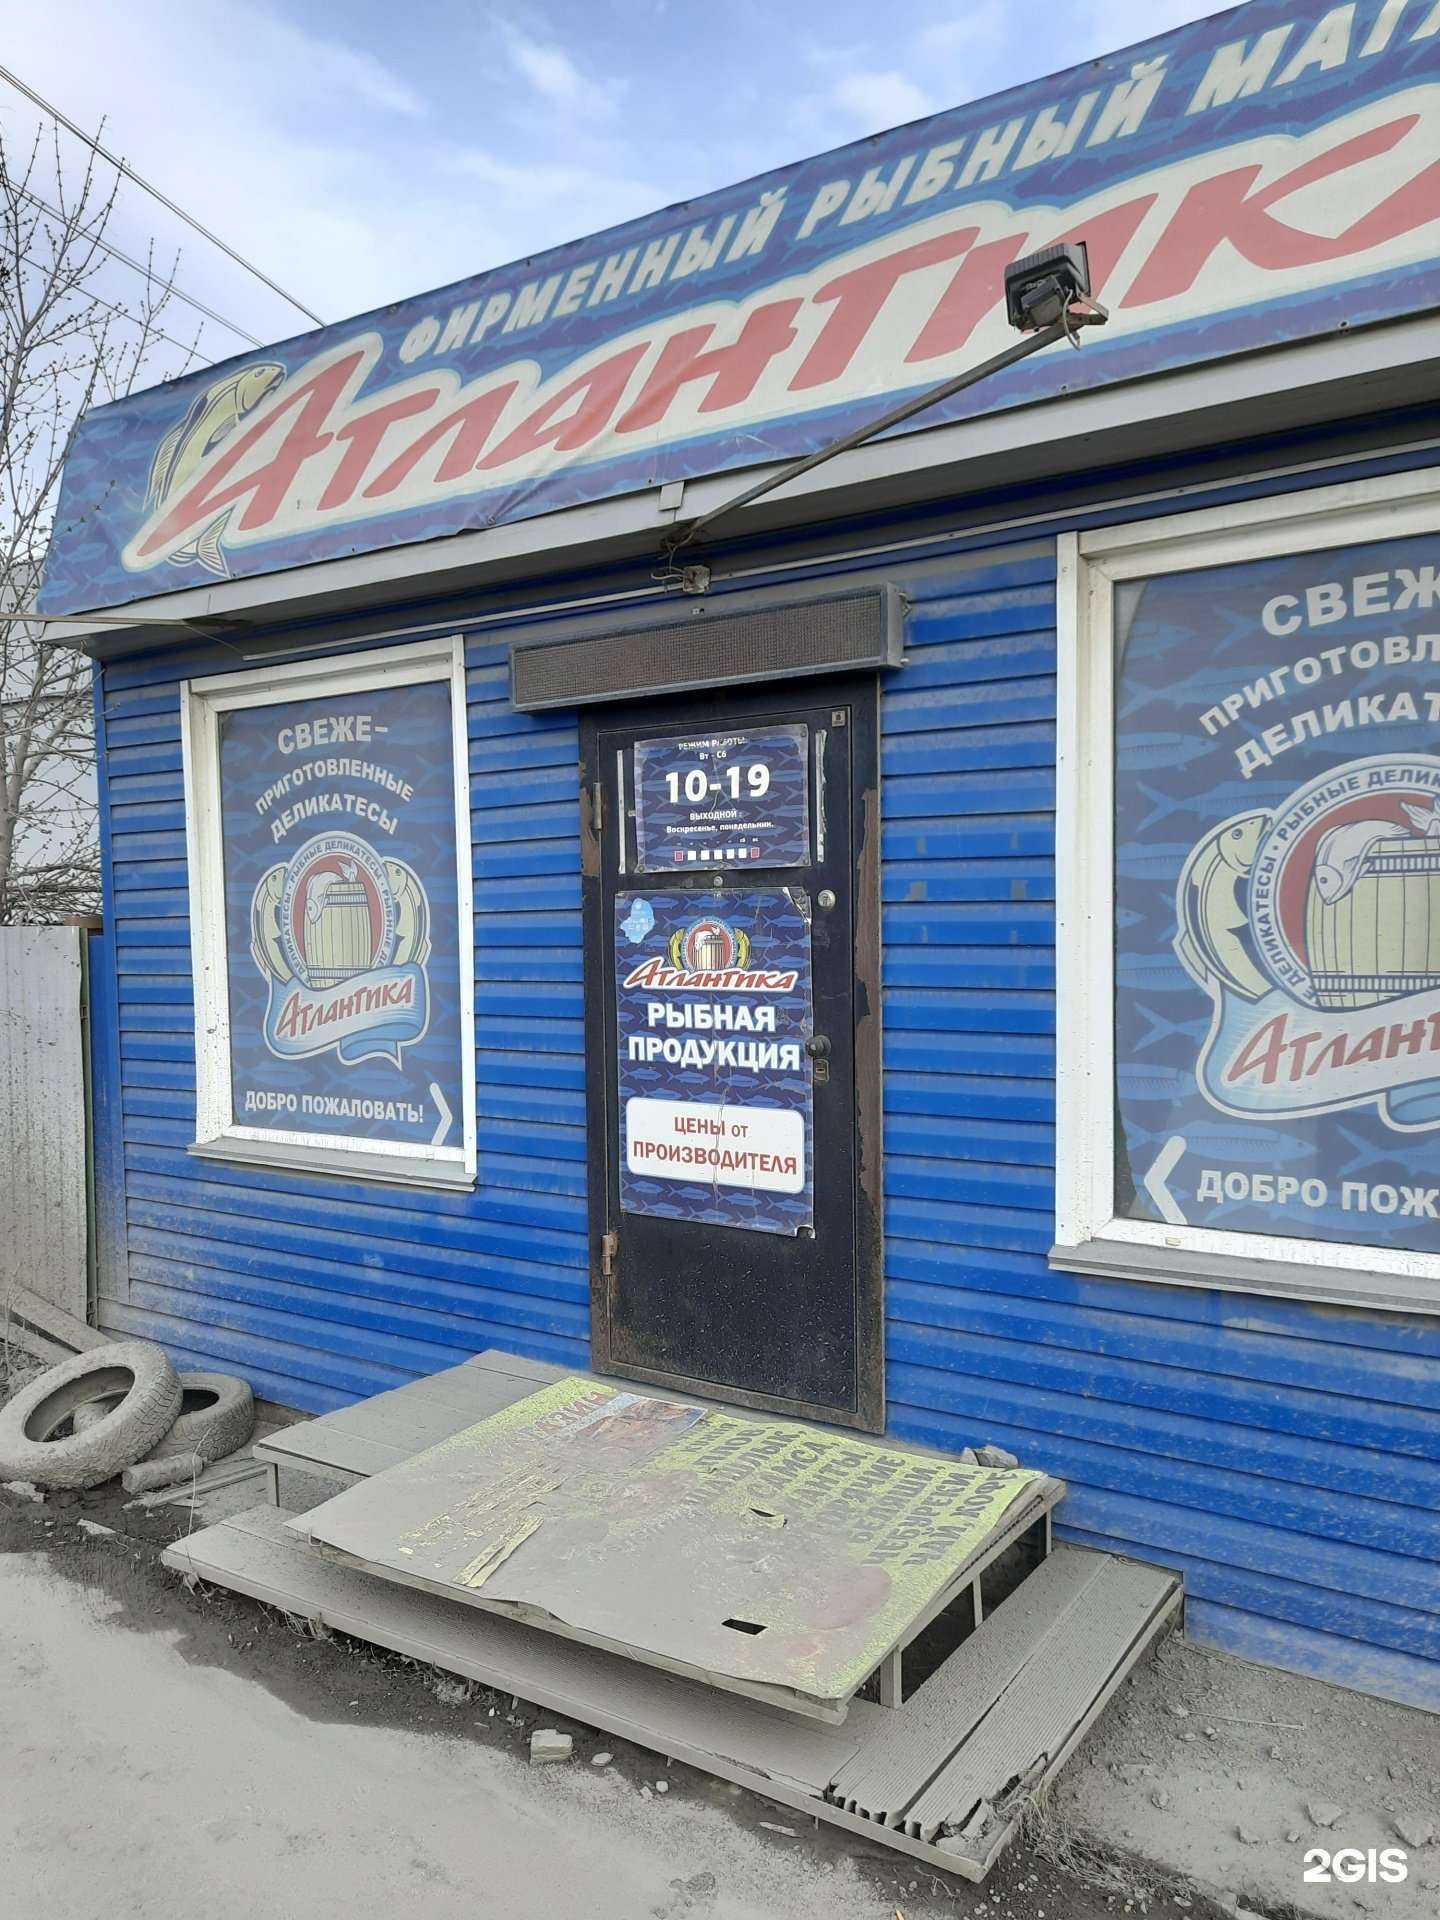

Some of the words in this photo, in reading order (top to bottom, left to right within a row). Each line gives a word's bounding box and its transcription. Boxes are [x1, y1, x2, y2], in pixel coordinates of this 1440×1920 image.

[400, 187, 788, 364] ФИРМЕННЫЙ
[796, 55, 1170, 240] РЫБНЫЙ
[137, 113, 1440, 557] АТЛАНТИК
[278, 715, 388, 753] СВЕЖЕ-
[255, 758, 414, 815] ПРИГОТОВЛЕННЫЕ
[665, 764, 770, 803] 10-19
[270, 793, 398, 843] ДЕЛИКАТЕСЫ
[1277, 776, 1360, 840] РЫБНЫЕ
[1256, 856, 1306, 986] ДЕЛИКАТЕСЫ
[648, 1003, 775, 1033] РЫБНАЯ
[629, 1036, 799, 1072] ПРОДУКЦИЯ
[245, 1091, 297, 1112] ДОБРО
[302, 1095, 424, 1123] ПОЖАЛОВАТЬ!
[674, 1117, 725, 1136] ЦЕНЫ
[633, 1141, 797, 1175] ПРОИЗВОДИТЕЛЯ
[1197, 1170, 1327, 1207] ДОБРО
